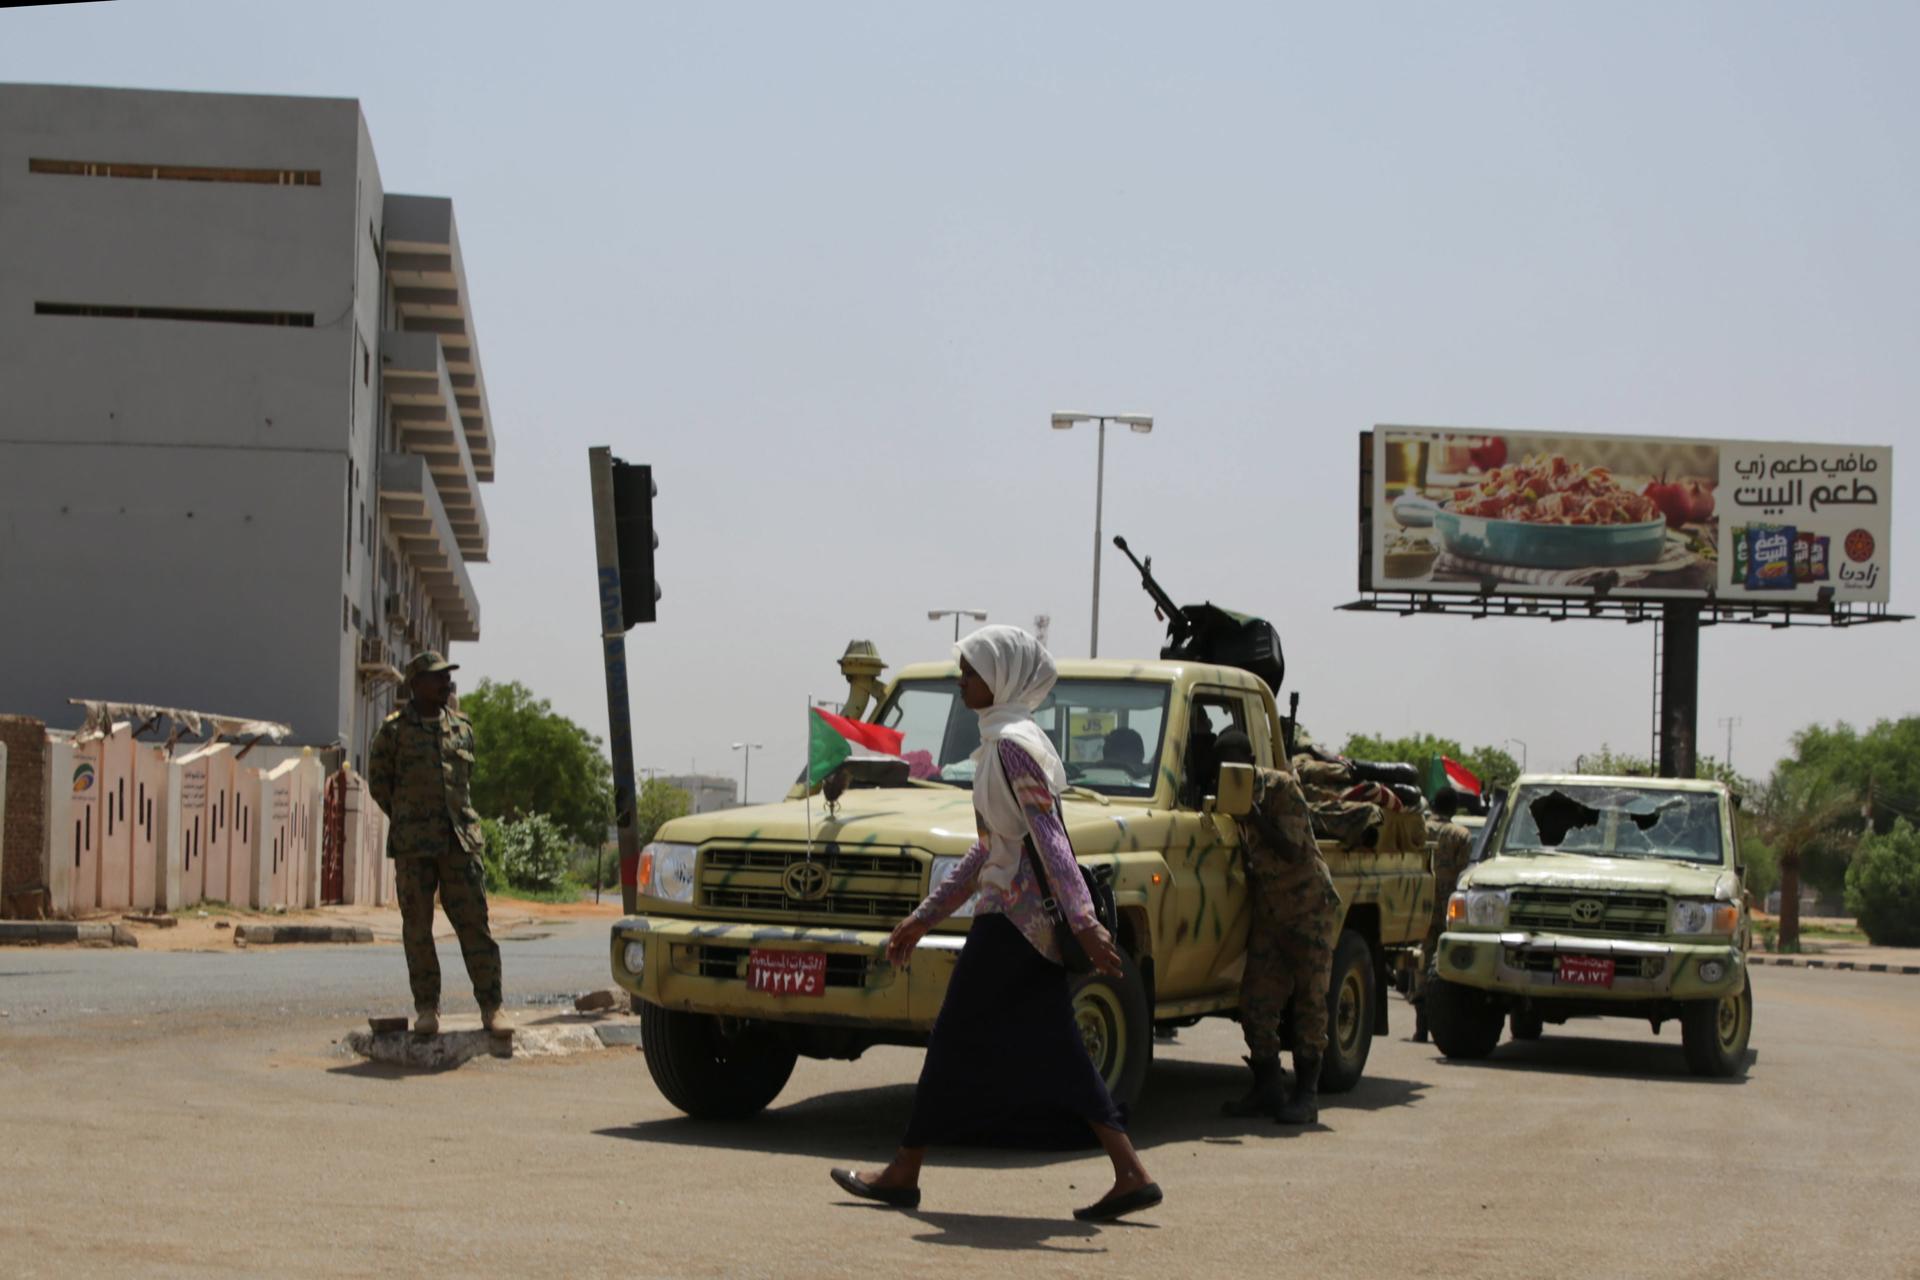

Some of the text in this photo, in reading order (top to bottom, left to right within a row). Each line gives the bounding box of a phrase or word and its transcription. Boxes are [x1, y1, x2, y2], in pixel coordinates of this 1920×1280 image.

[1734, 454, 1765, 480] زي
[1770, 454, 1818, 479] طعم
[1734, 478, 1878, 515] طعم البيت
[1839, 562, 1880, 589] زادنا
